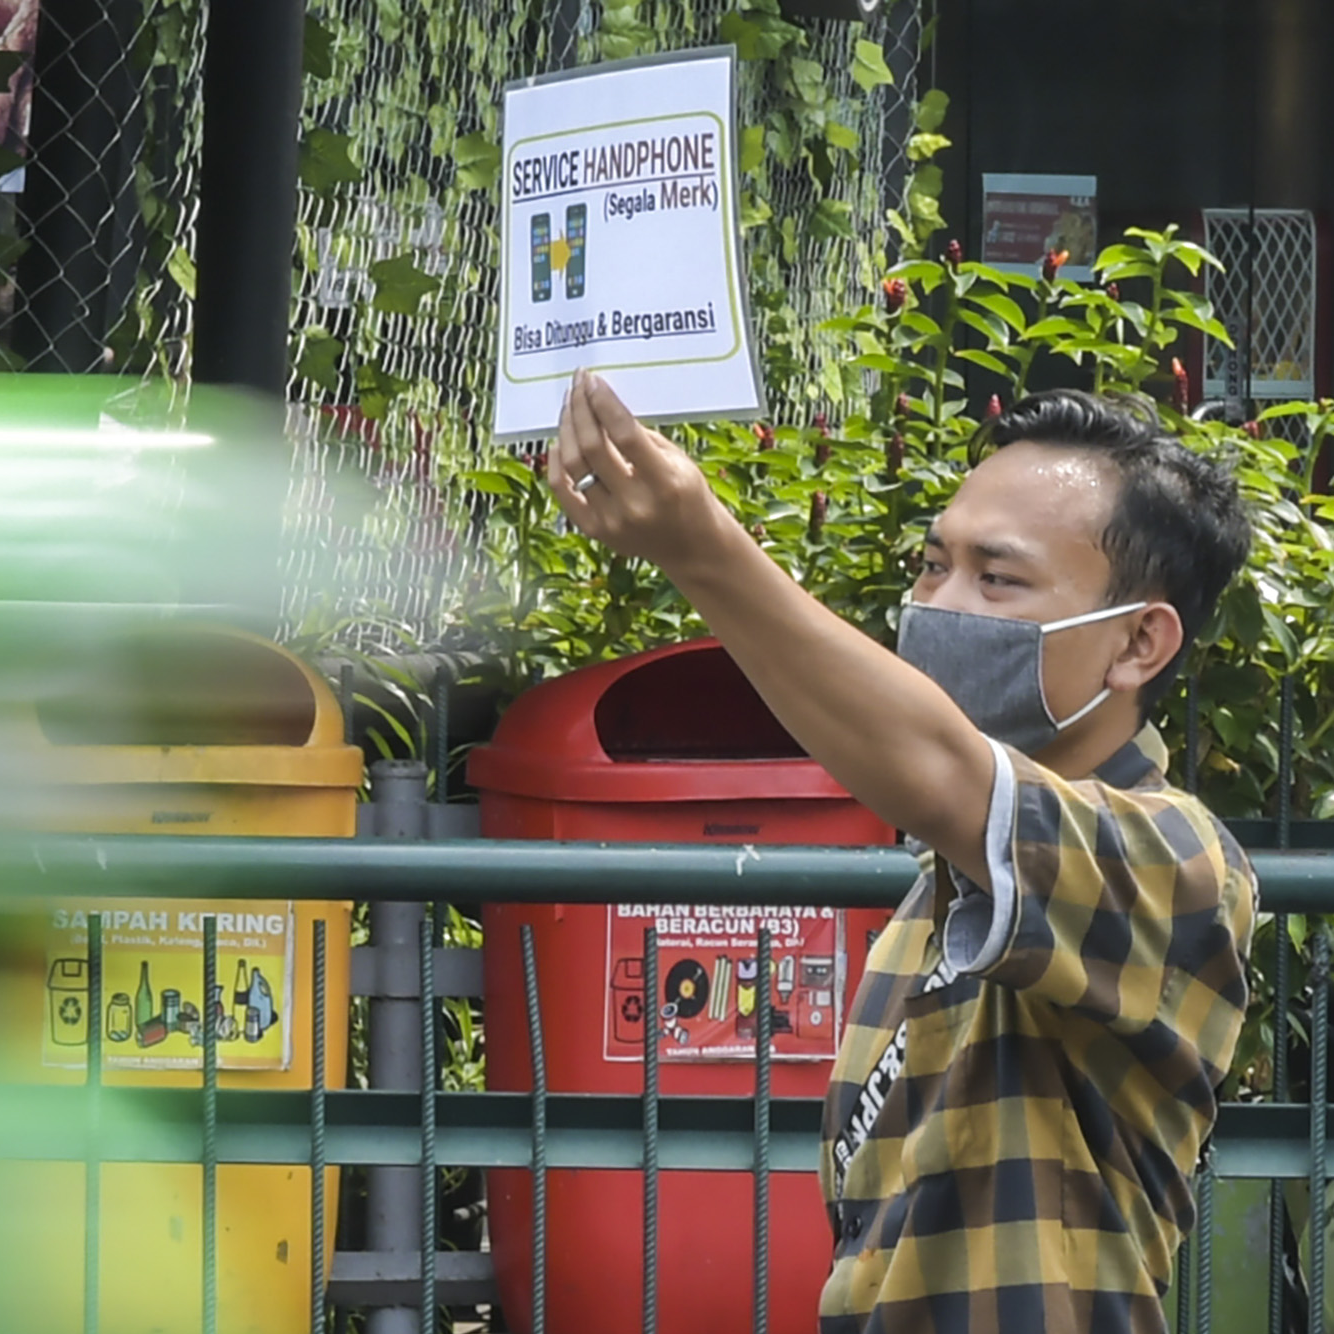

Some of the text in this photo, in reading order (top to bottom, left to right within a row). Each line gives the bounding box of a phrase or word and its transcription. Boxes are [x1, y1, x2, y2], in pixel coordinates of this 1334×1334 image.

[512, 132, 715, 197] SERVICE HANDPHONE
[603, 175, 718, 224] (Segala Merk)
[513, 301, 716, 352] Bisa Ditunggu & Bergaransi
[655, 918, 755, 935] BERACUN
